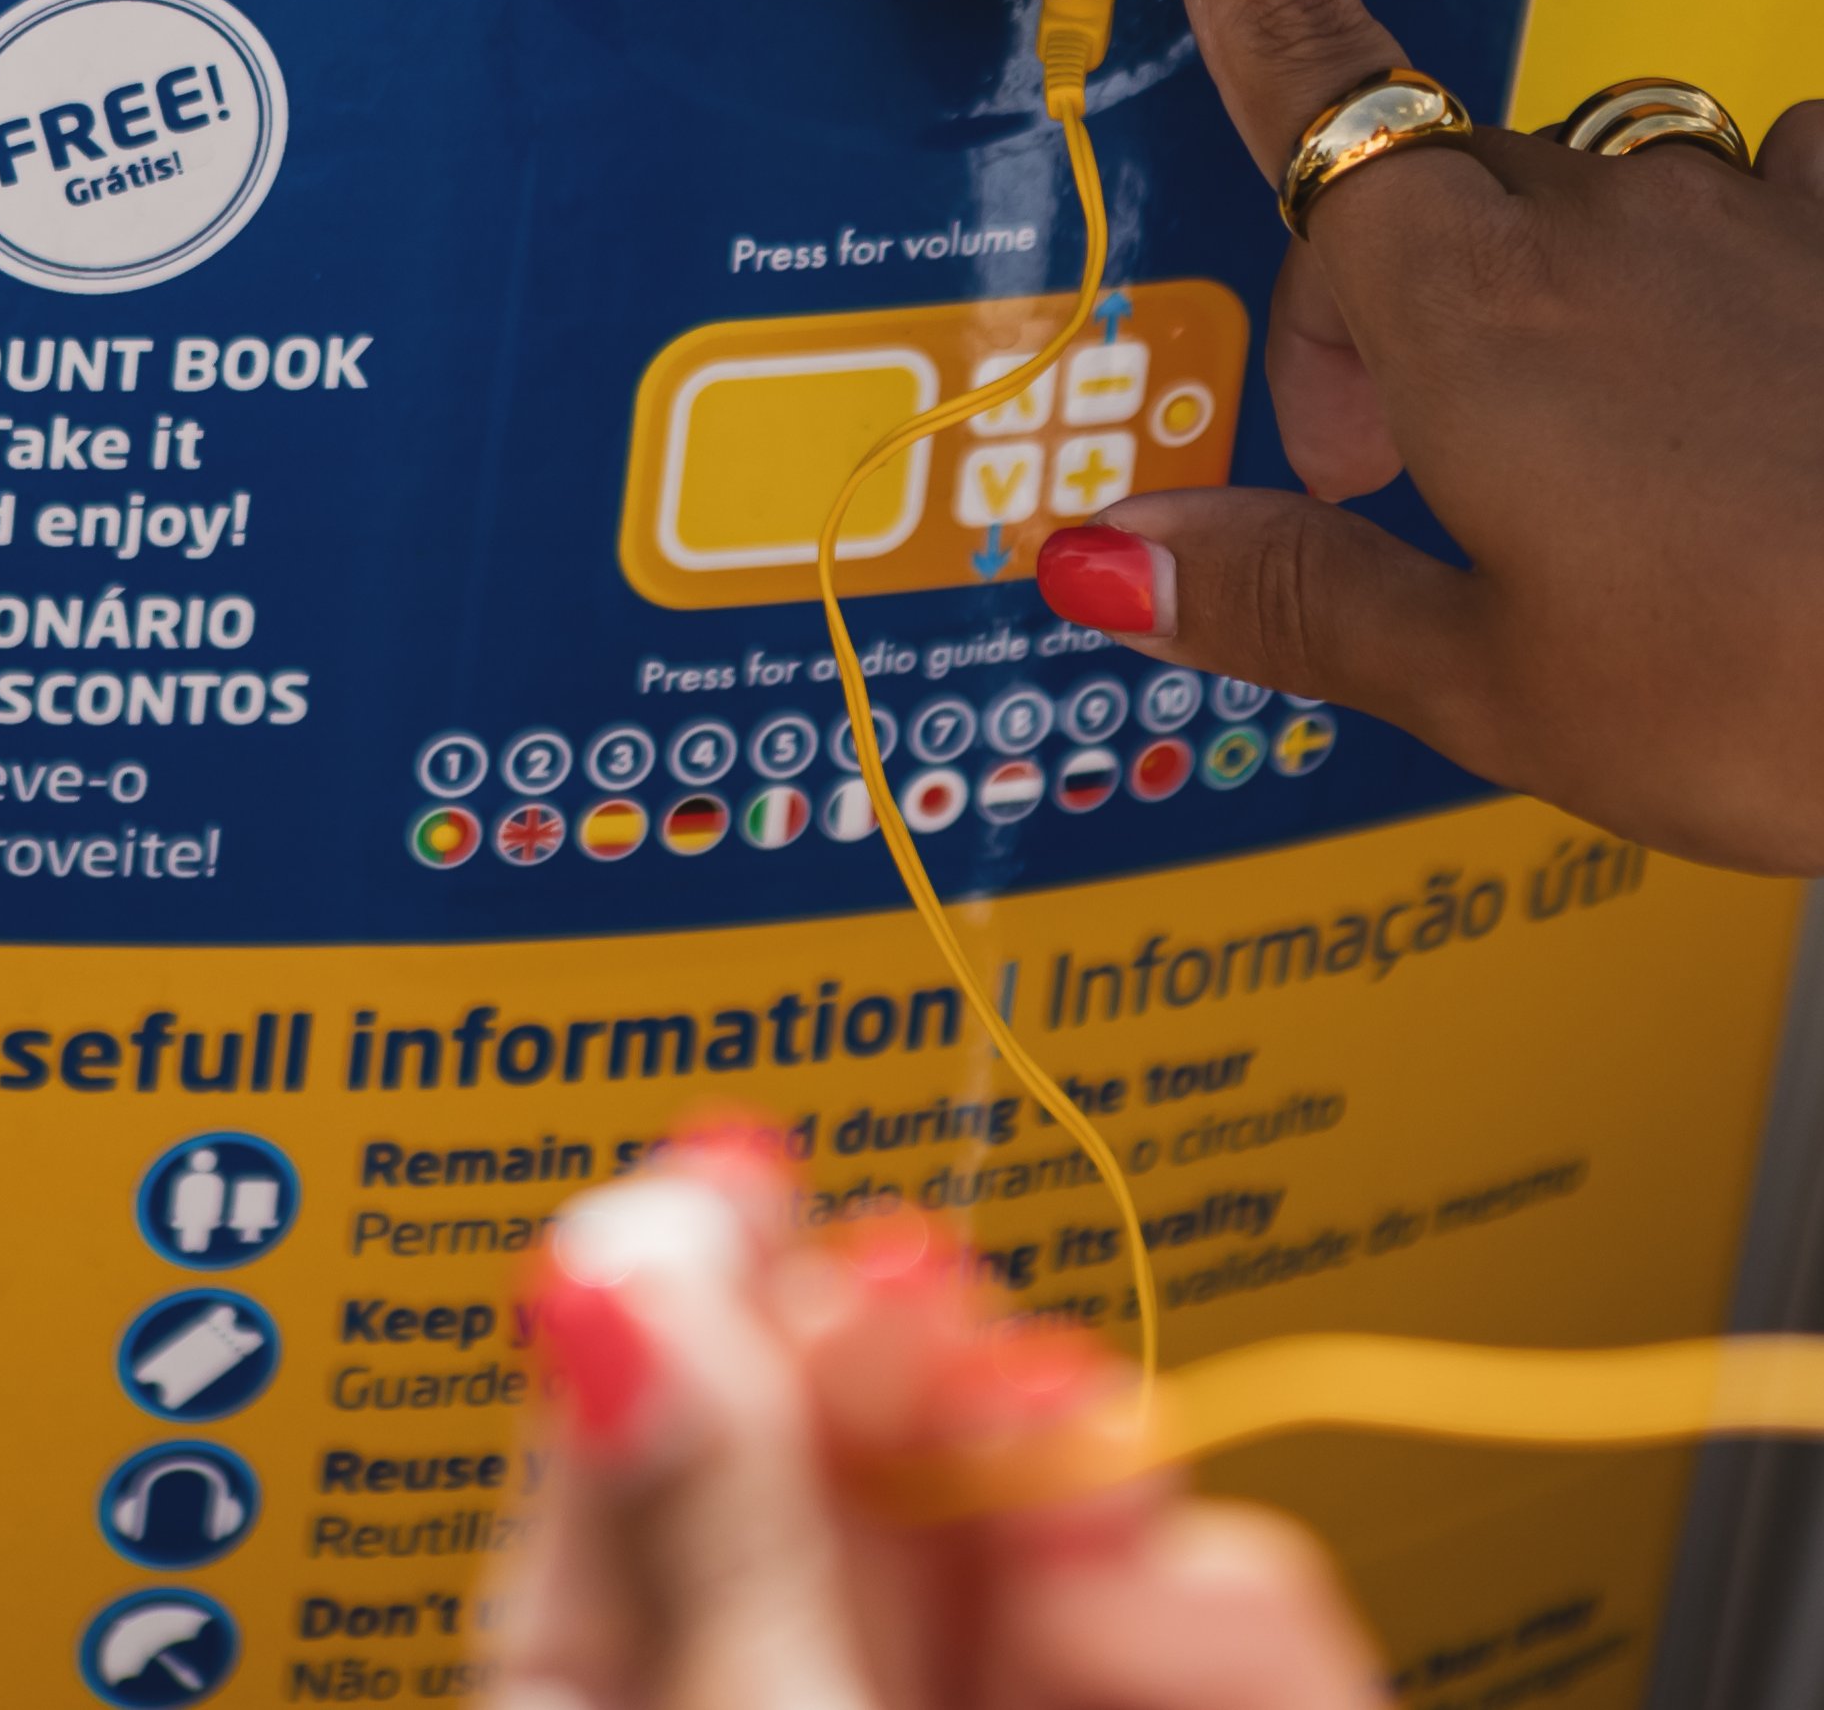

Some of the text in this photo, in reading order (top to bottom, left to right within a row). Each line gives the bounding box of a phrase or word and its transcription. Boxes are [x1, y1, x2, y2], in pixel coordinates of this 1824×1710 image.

[64, 149, 184, 207] Grátis!
[732, 220, 1037, 273] Press for volume
[172, 332, 374, 392] BOOK
[151, 415, 204, 472] it
[36, 493, 250, 560] enjoy!
[641, 659, 736, 695] Press
[745, 652, 802, 687] for
[810, 640, 918, 682] adio
[924, 625, 1028, 681] guide
[347, 979, 962, 1091] information
[1047, 867, 1510, 1031] Informação
[361, 1136, 594, 1189] Remain
[832, 1096, 1021, 1157] during
[1144, 1048, 1257, 1106] tour
[1128, 1136, 1158, 1176] o
[1174, 1091, 1348, 1167] circuito
[340, 1299, 496, 1350] Keep
[1052, 1226, 1121, 1271] its
[330, 1363, 529, 1413] Guarde
[320, 1449, 508, 1494] Reuse
[299, 1590, 462, 1641] Don't
[289, 1657, 403, 1702] Não
